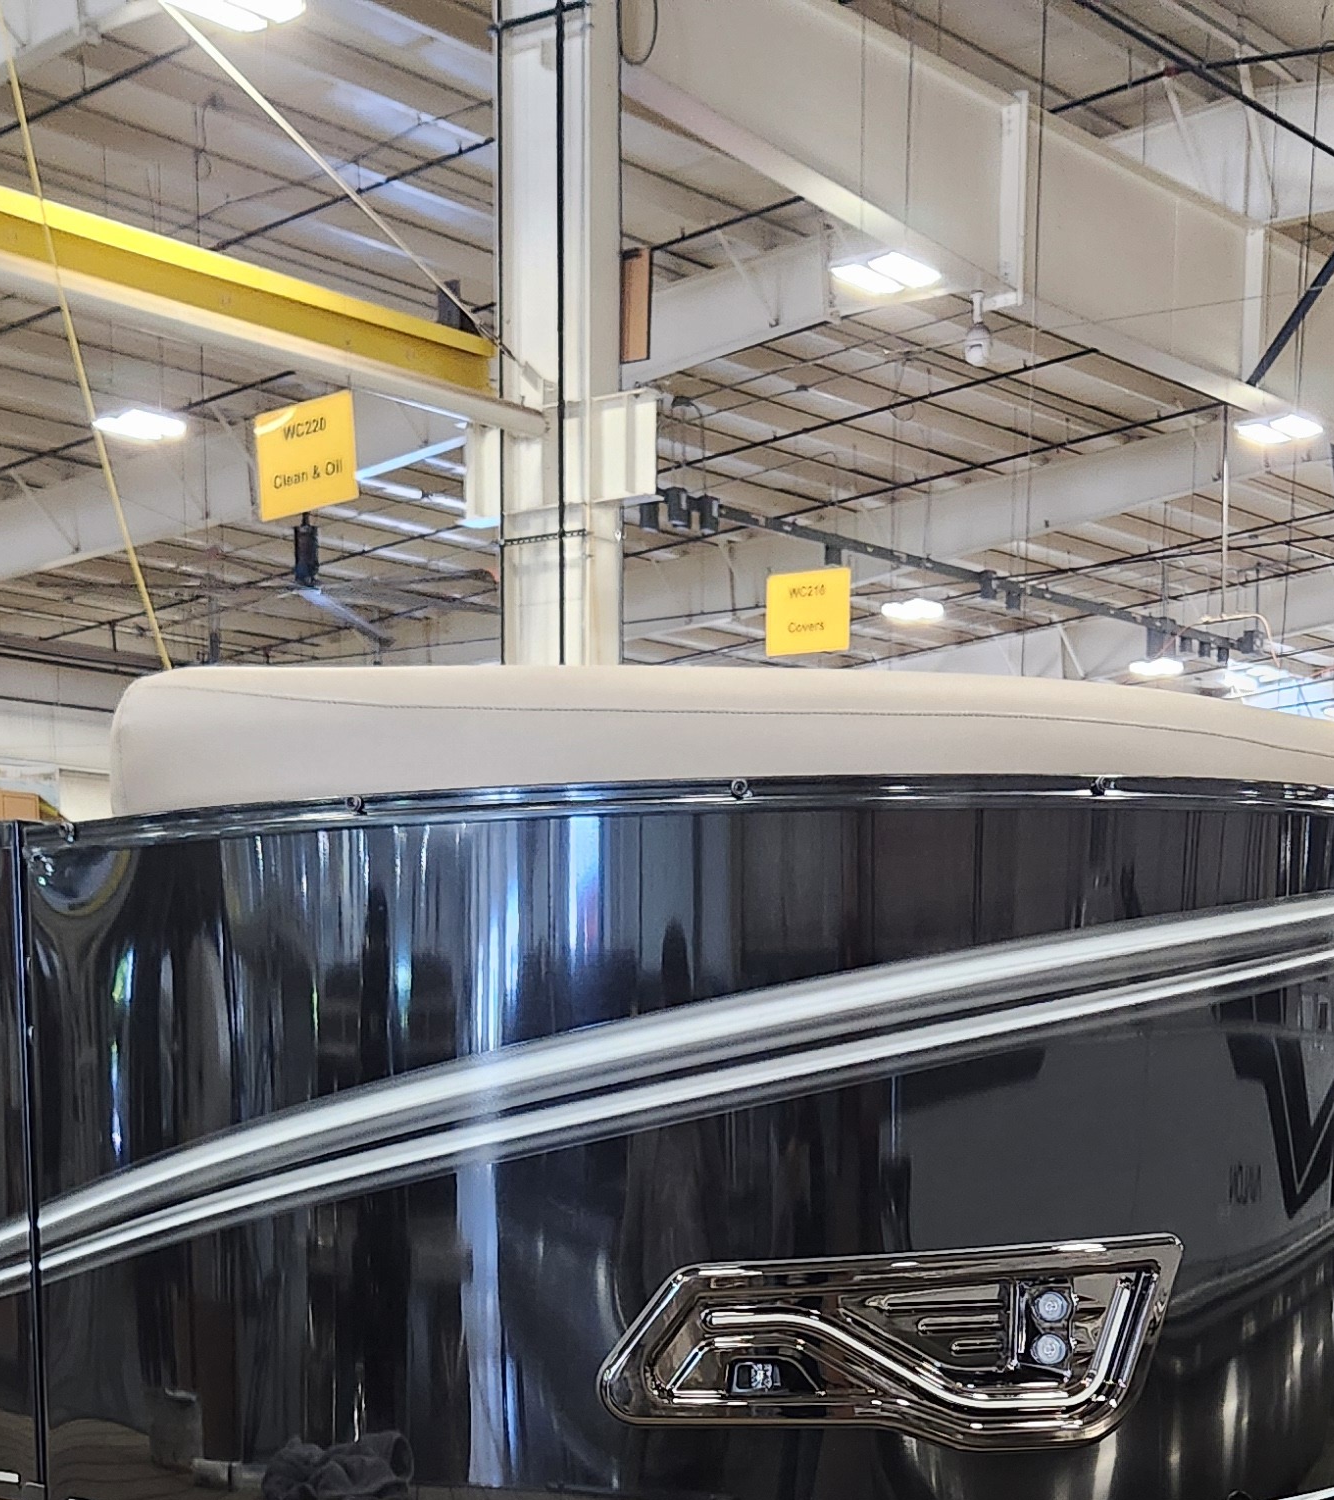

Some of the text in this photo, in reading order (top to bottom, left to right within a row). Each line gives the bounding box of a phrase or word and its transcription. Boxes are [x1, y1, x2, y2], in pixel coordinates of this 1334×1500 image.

[283, 416, 327, 440] WC220
[273, 459, 343, 490] Clean & Oil
[788, 621, 825, 633] Covers
